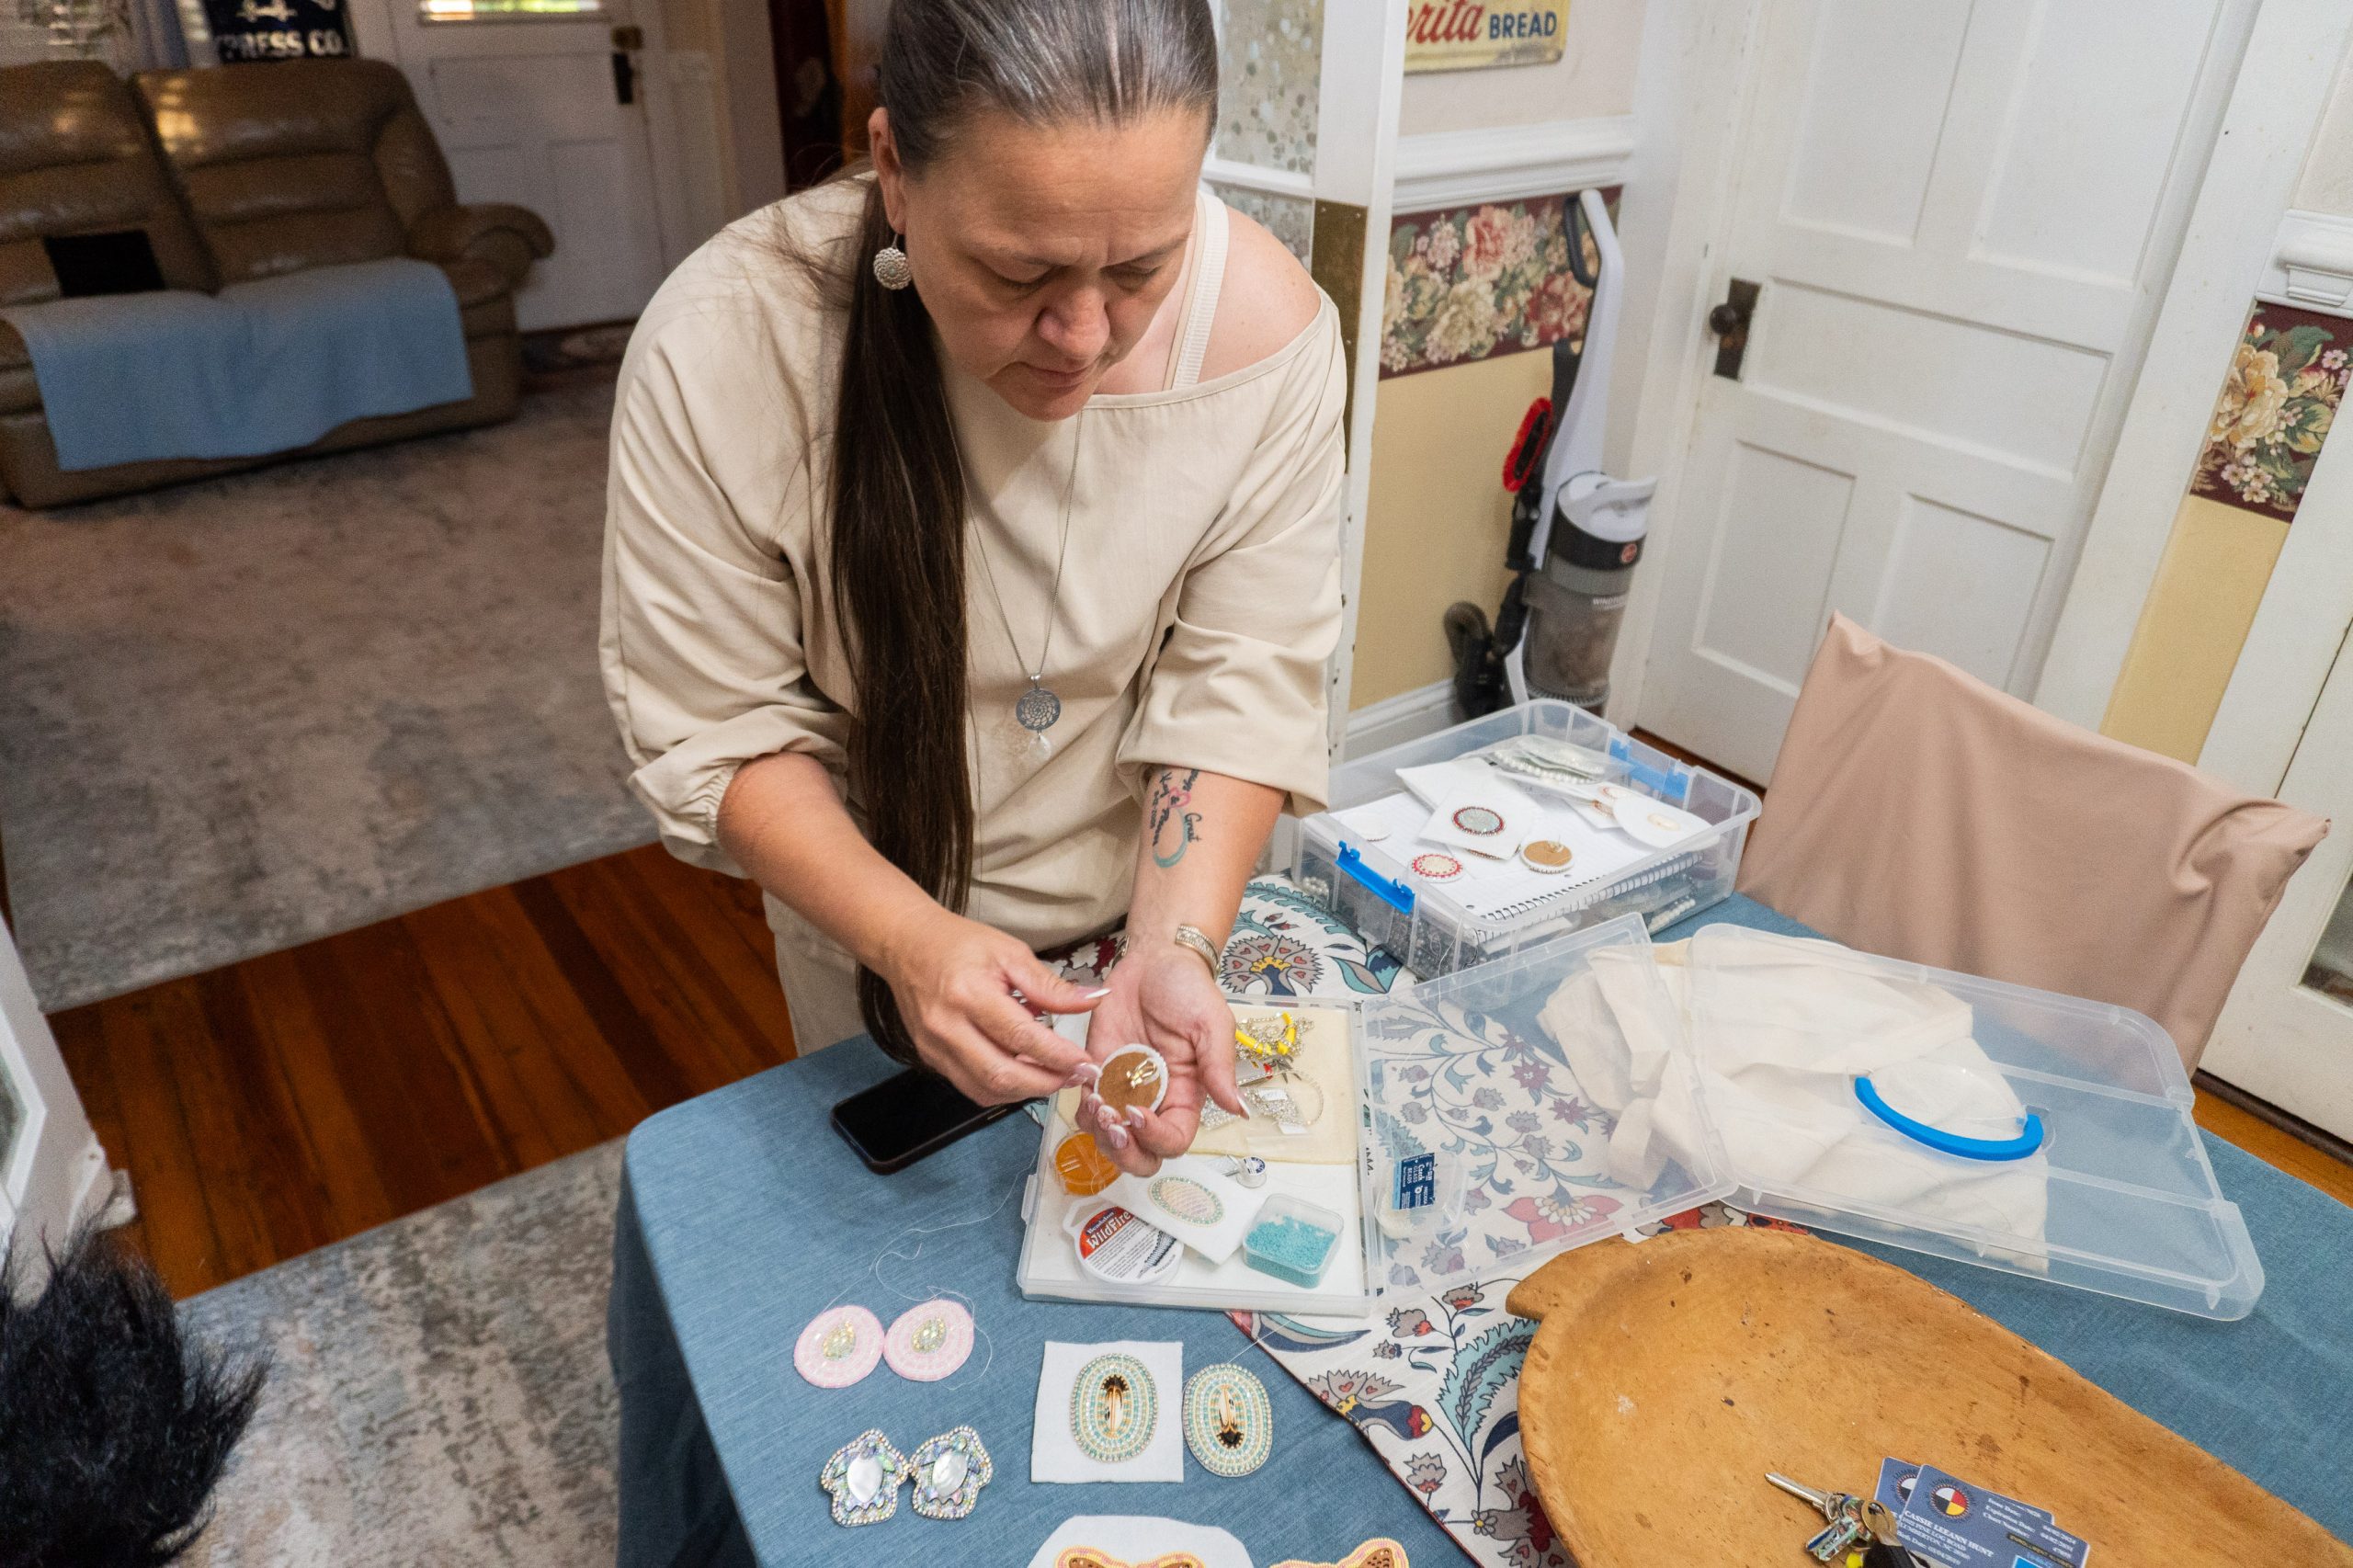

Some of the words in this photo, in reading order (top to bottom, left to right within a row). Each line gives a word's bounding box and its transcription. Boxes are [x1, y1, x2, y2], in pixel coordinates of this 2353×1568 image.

[1488, 11, 1558, 40] BREAD
[1086, 1210, 1132, 1250] WildFire
[1904, 1510, 1932, 1528] CASSIE
[1968, 1541, 1995, 1558] HUNT
